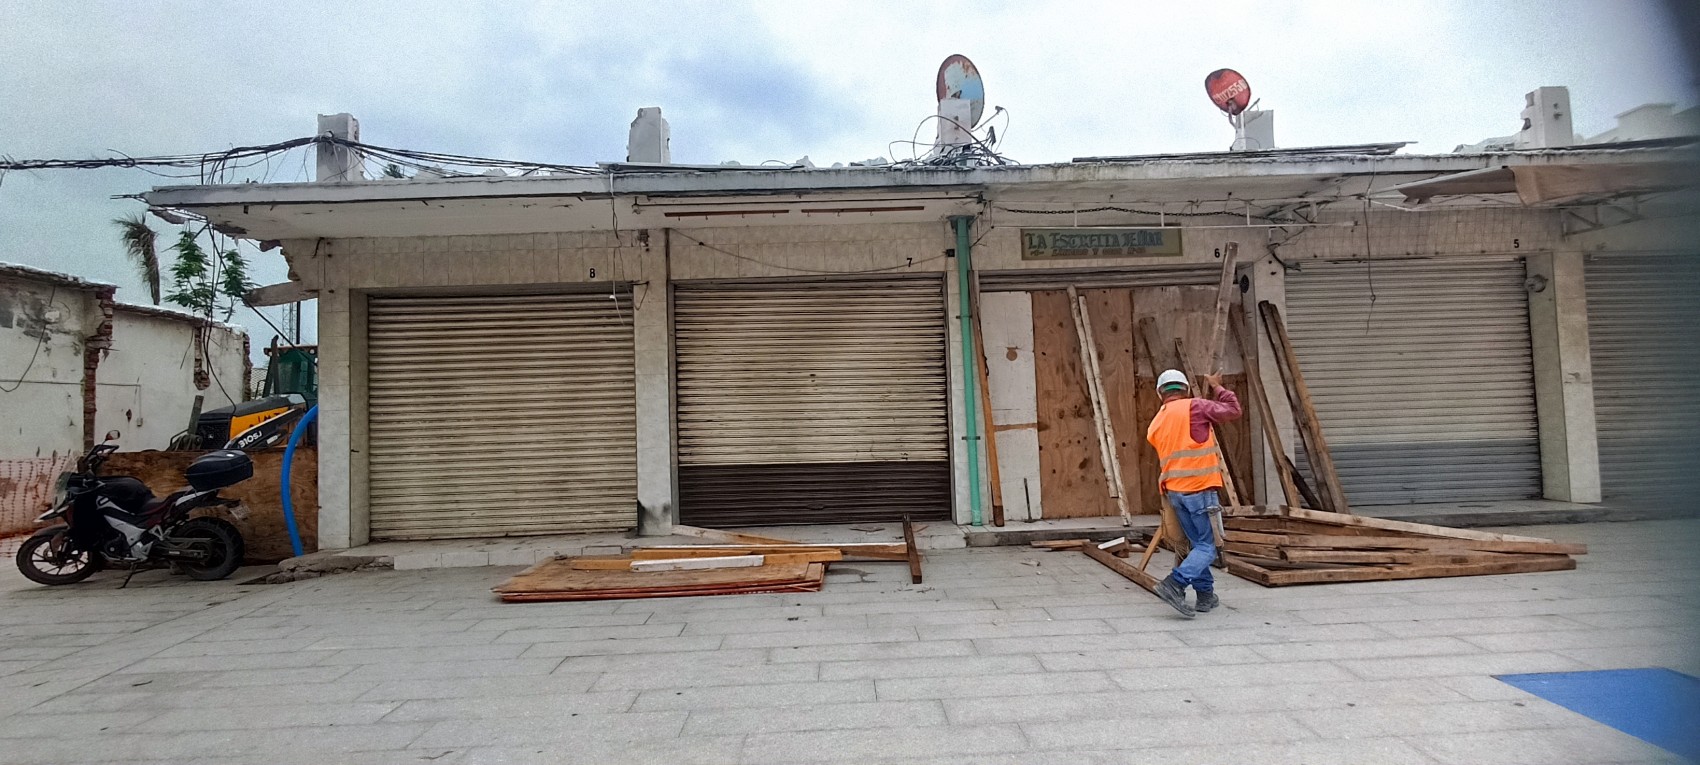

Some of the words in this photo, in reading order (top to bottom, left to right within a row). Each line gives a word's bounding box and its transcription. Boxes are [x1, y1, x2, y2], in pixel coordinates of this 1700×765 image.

[1025, 232, 1047, 249] LA
[1514, 239, 1520, 248] 5
[1214, 248, 1221, 258] 6
[906, 257, 913, 267] 7
[589, 267, 596, 278] 8
[238, 430, 263, 449] 310SJ
